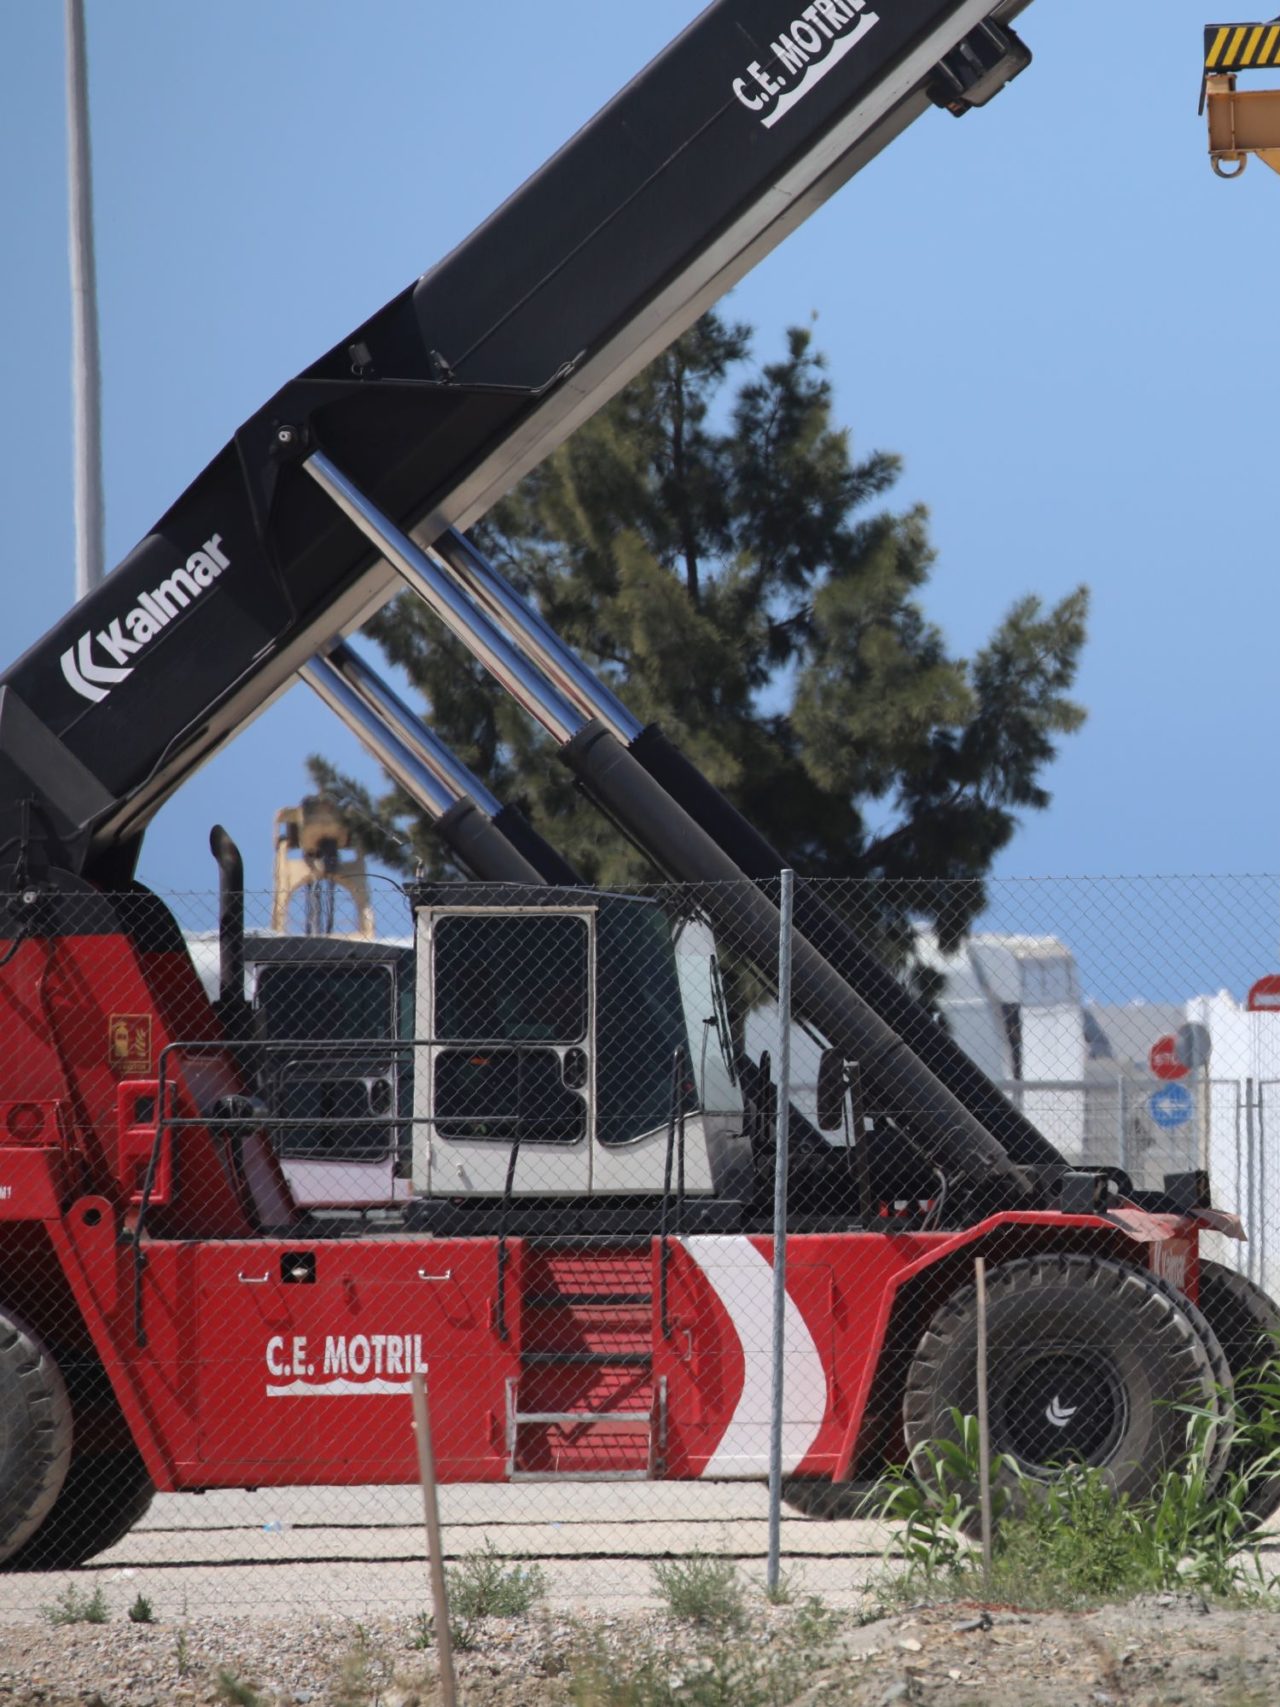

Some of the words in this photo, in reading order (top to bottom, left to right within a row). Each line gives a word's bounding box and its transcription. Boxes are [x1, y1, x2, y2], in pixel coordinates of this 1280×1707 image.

[732, 60, 787, 111] C.E.
[95, 533, 231, 666] Kalmar
[266, 1335, 315, 1376] C.E.
[323, 1333, 429, 1374] MOTRIL
